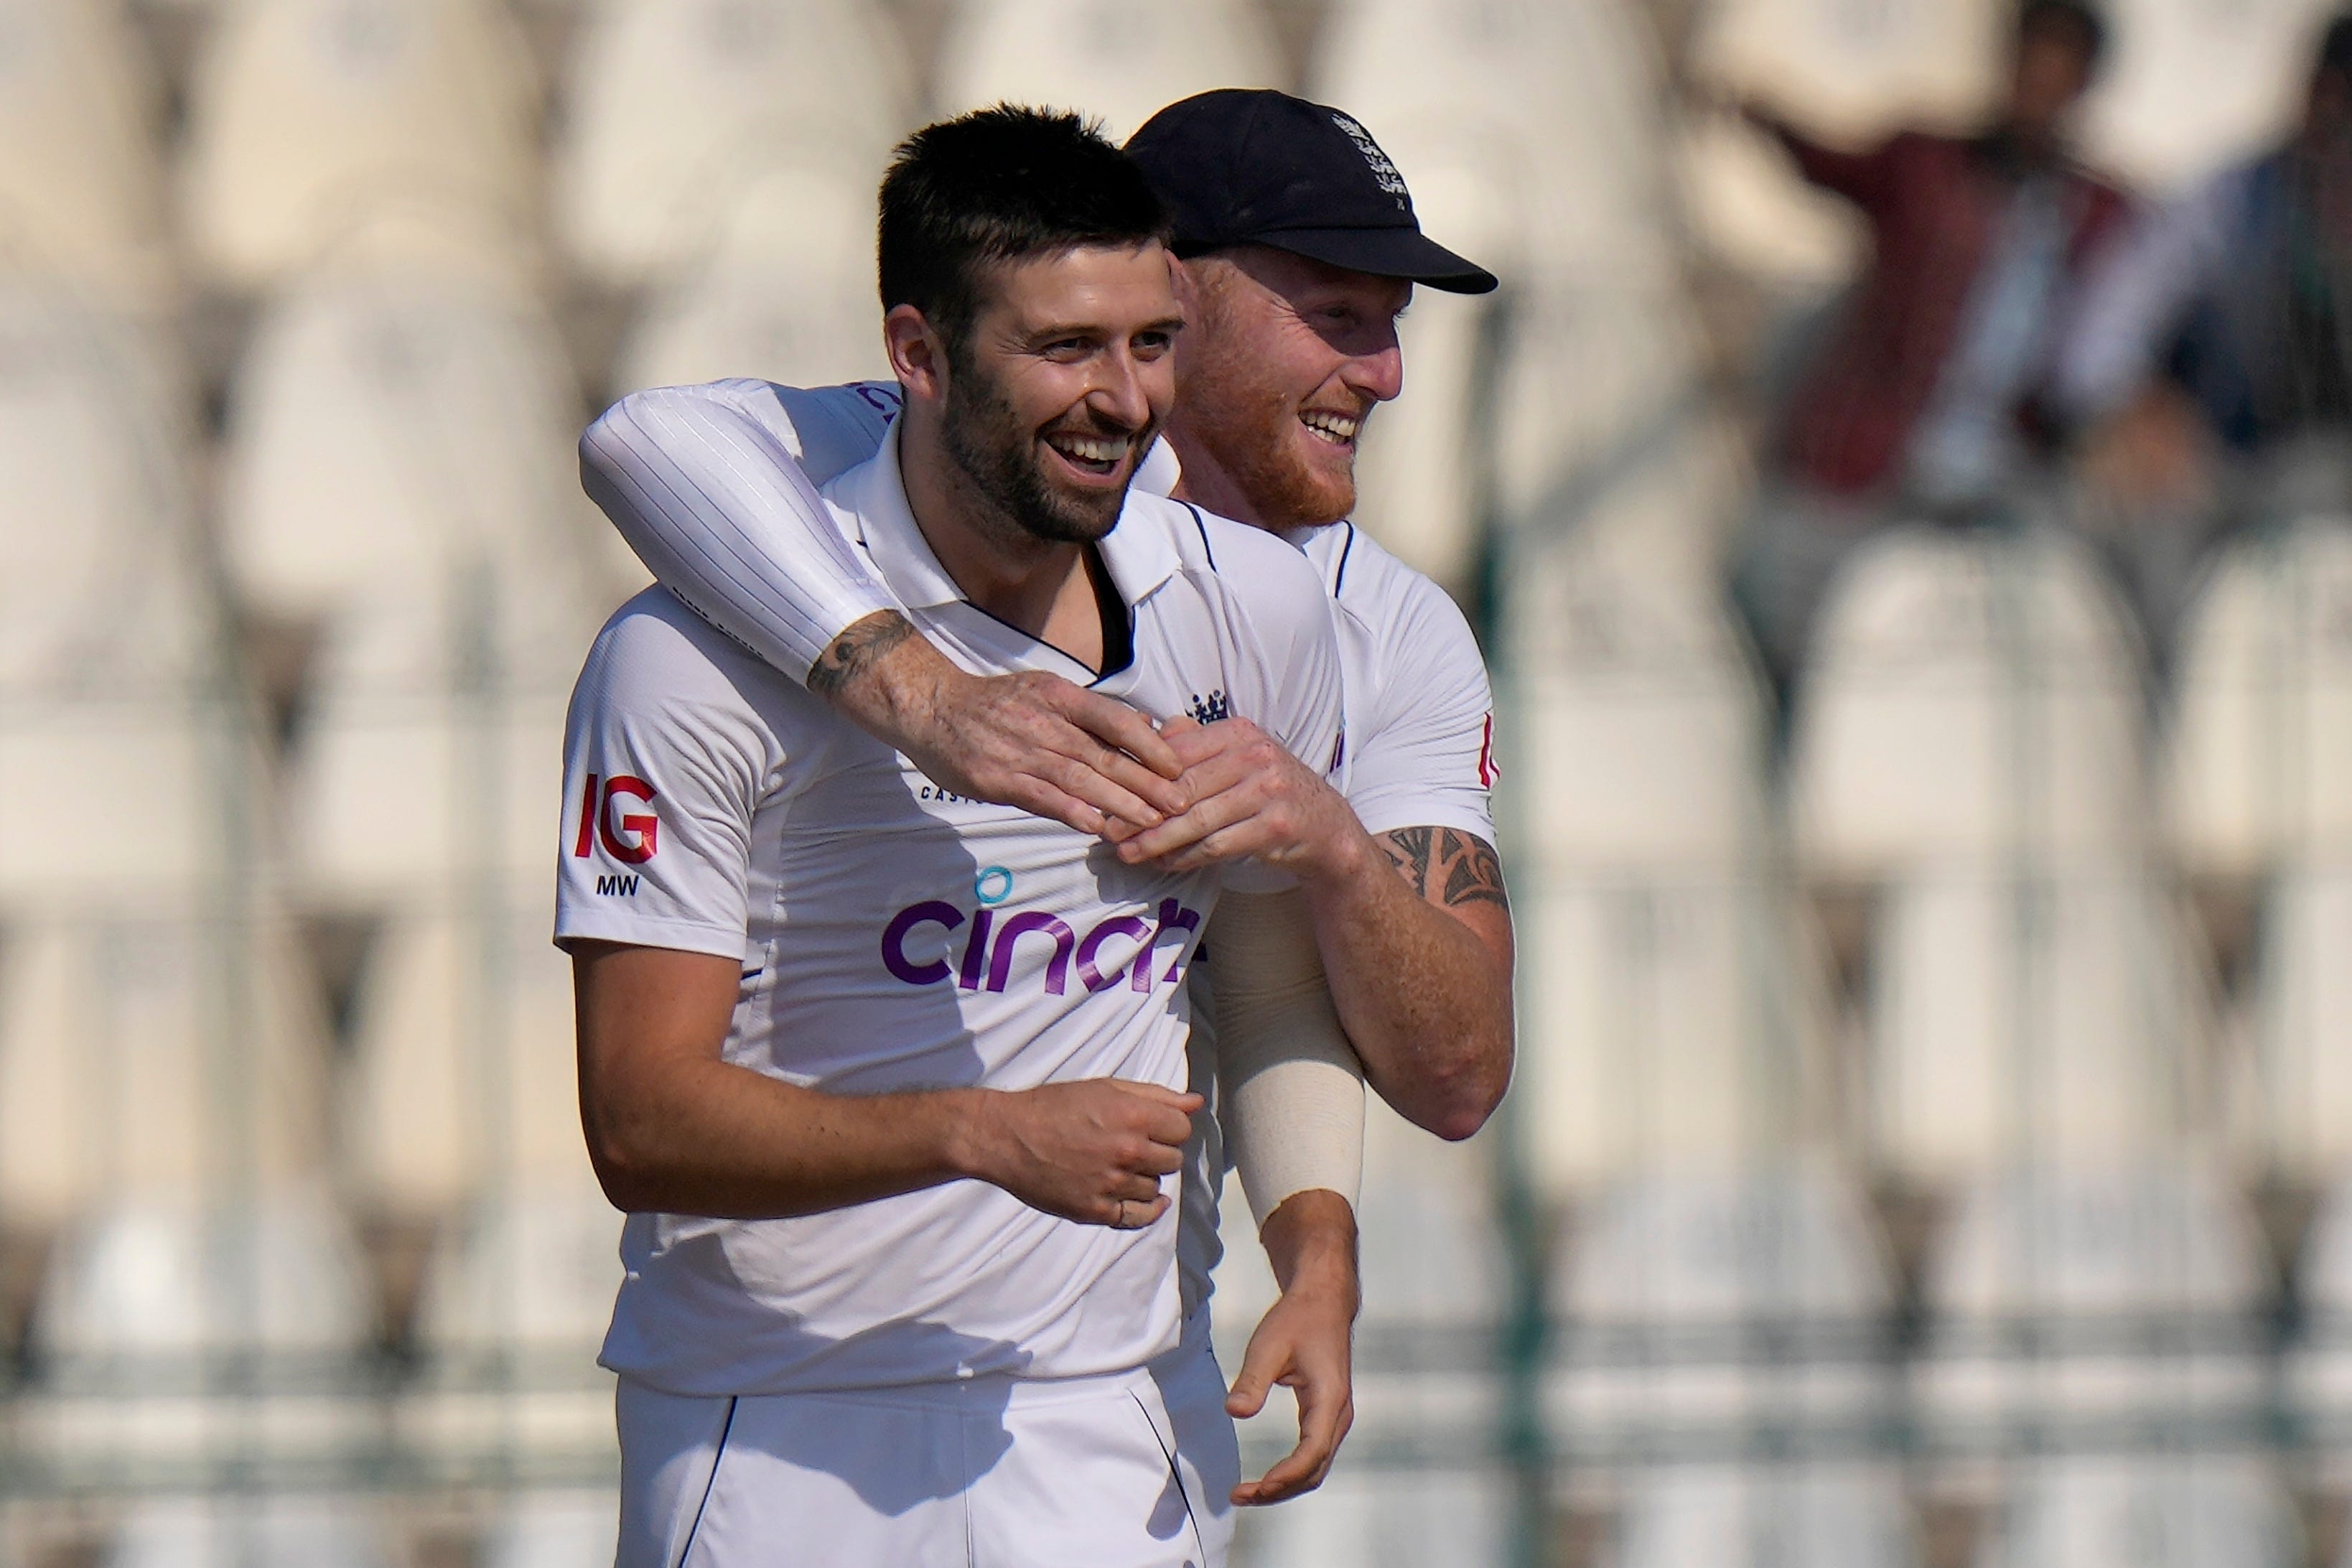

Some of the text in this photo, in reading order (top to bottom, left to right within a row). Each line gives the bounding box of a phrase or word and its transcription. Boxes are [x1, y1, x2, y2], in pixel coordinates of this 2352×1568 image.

[575, 773, 658, 864] IG
[597, 874, 639, 896] MW
[882, 866, 1200, 996] cinch
